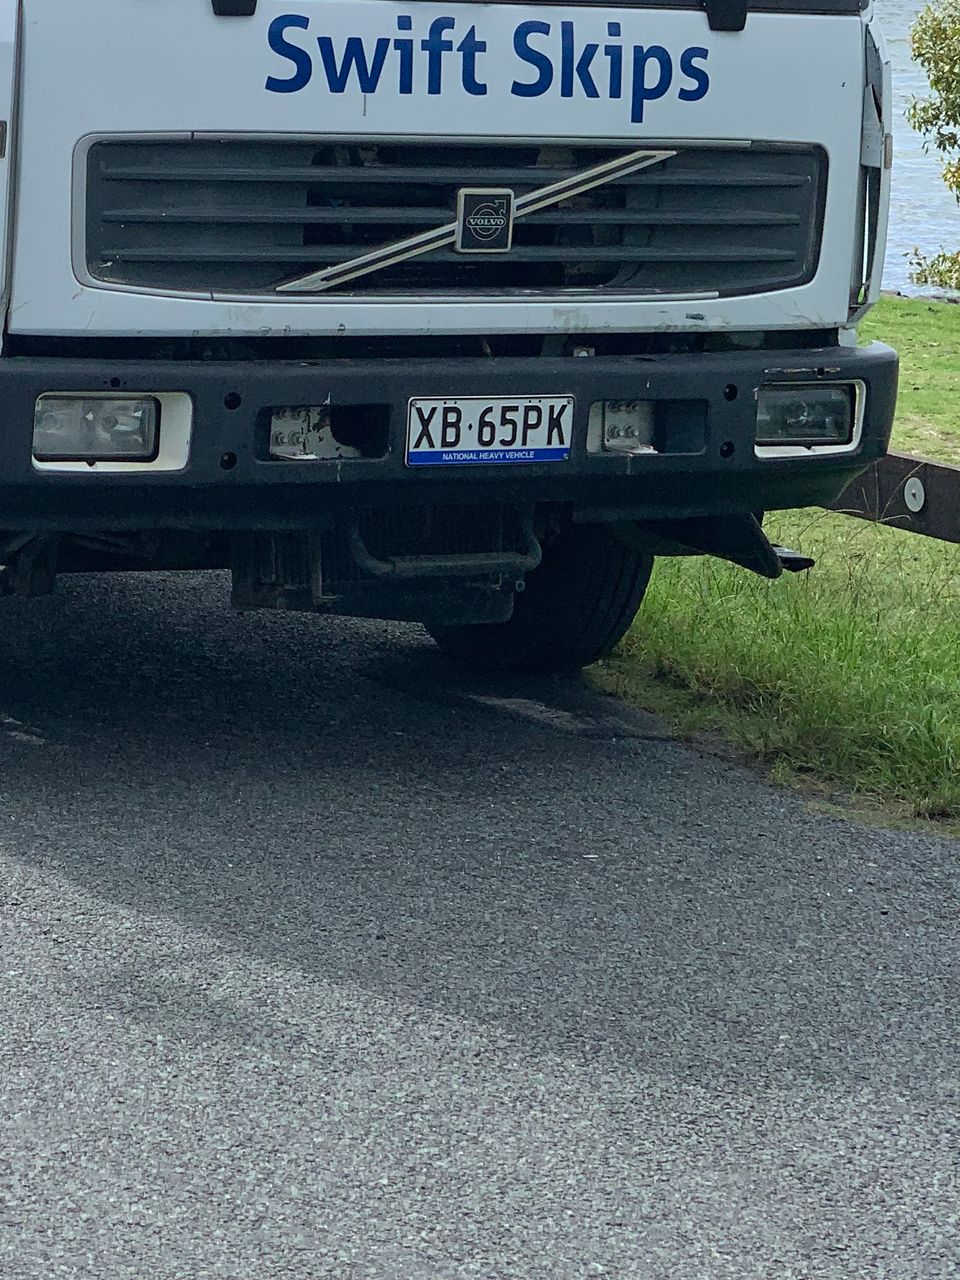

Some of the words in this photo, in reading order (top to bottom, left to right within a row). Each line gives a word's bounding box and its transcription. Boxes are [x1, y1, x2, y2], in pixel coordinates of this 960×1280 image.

[265, 13, 488, 96] Swift
[510, 20, 710, 124] Skips
[442, 452, 478, 461] NATIONAL
[479, 452, 505, 460] HEAVY
[505, 450, 535, 459] VEHICLE
